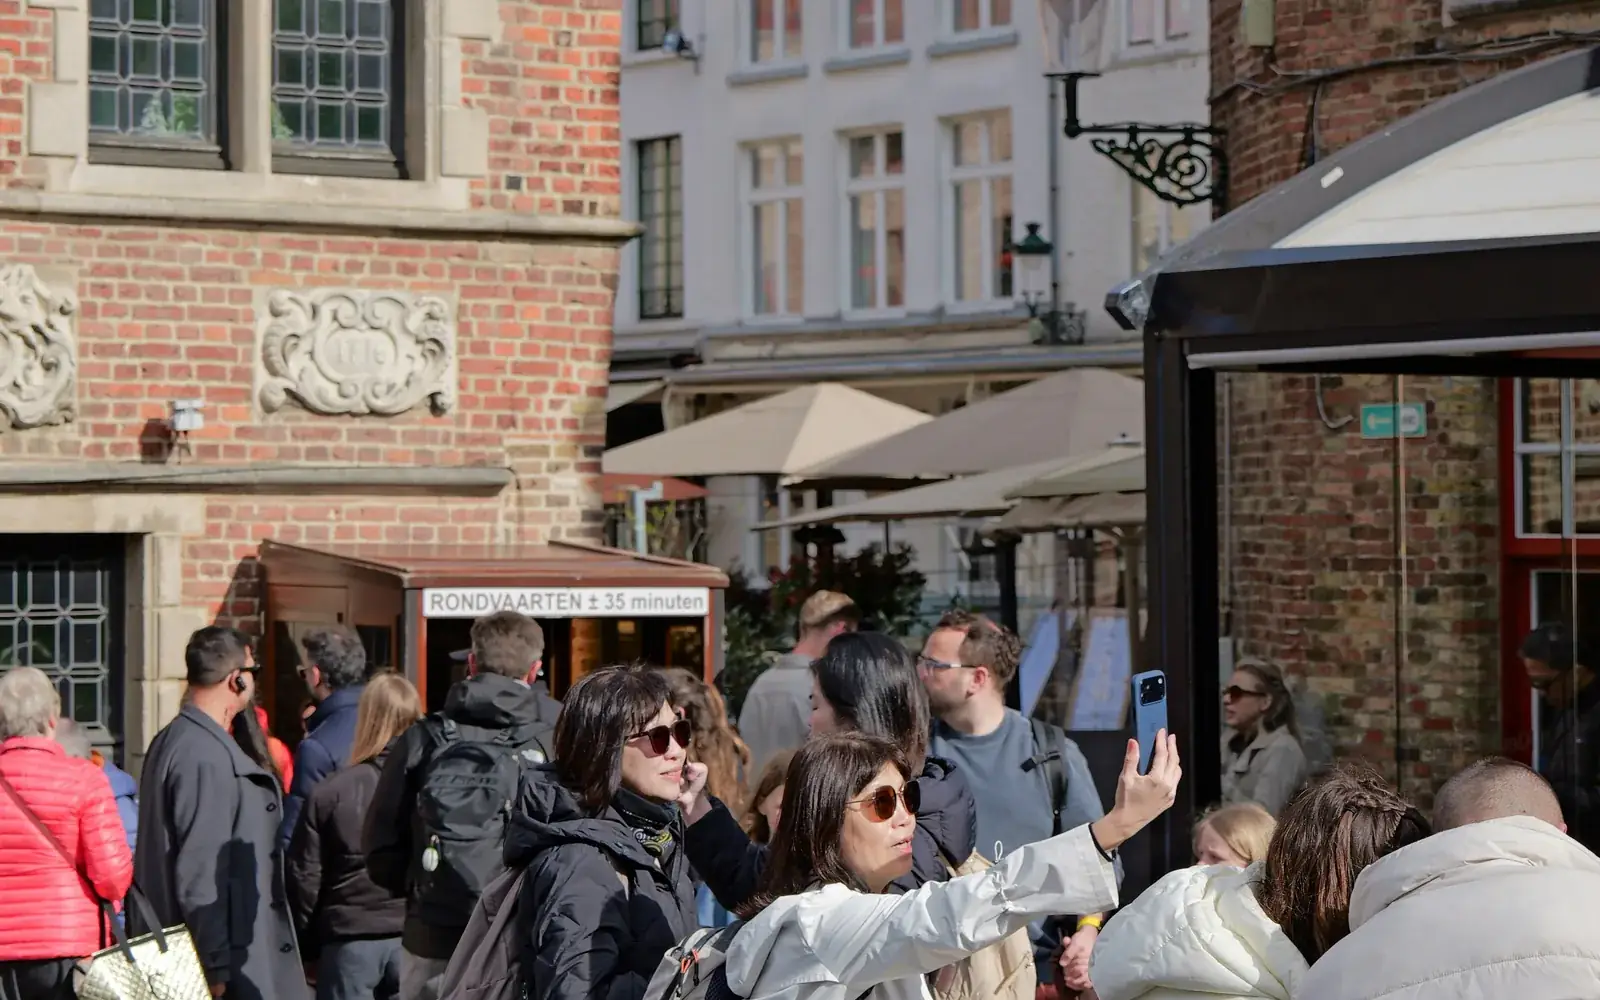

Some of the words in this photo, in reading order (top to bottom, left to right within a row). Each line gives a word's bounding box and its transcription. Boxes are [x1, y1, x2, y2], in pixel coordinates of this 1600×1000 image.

[431, 593, 582, 611] RONDVAARTEN
[588, 594, 599, 610] ±
[604, 592, 626, 610] 35
[631, 592, 703, 610] minuten
